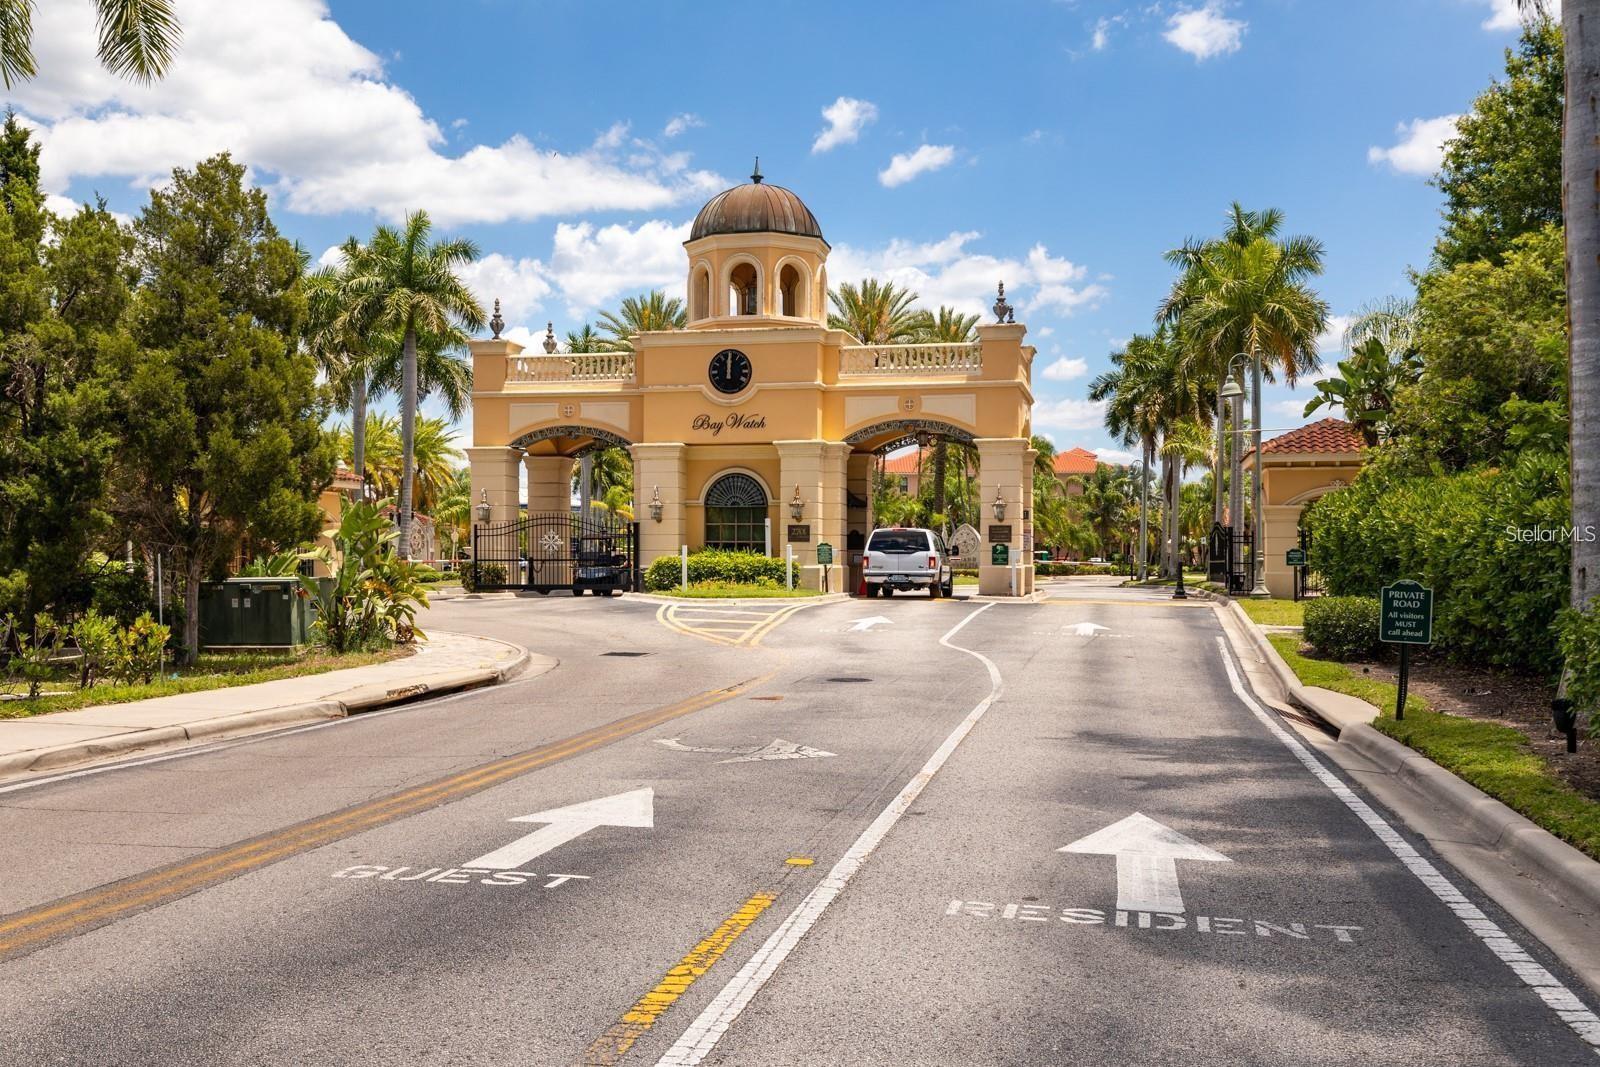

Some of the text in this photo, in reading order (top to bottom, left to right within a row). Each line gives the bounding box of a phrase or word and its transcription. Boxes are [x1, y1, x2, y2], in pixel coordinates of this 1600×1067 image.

[692, 412, 767, 436] Bay Watch
[1389, 590, 1425, 600] PRIVATE
[1393, 600, 1421, 608] ROAD
[1400, 611, 1425, 620] visitors
[1394, 620, 1417, 628] MUST
[331, 865, 592, 888] GUEST
[945, 900, 1364, 942] RESIDENT
